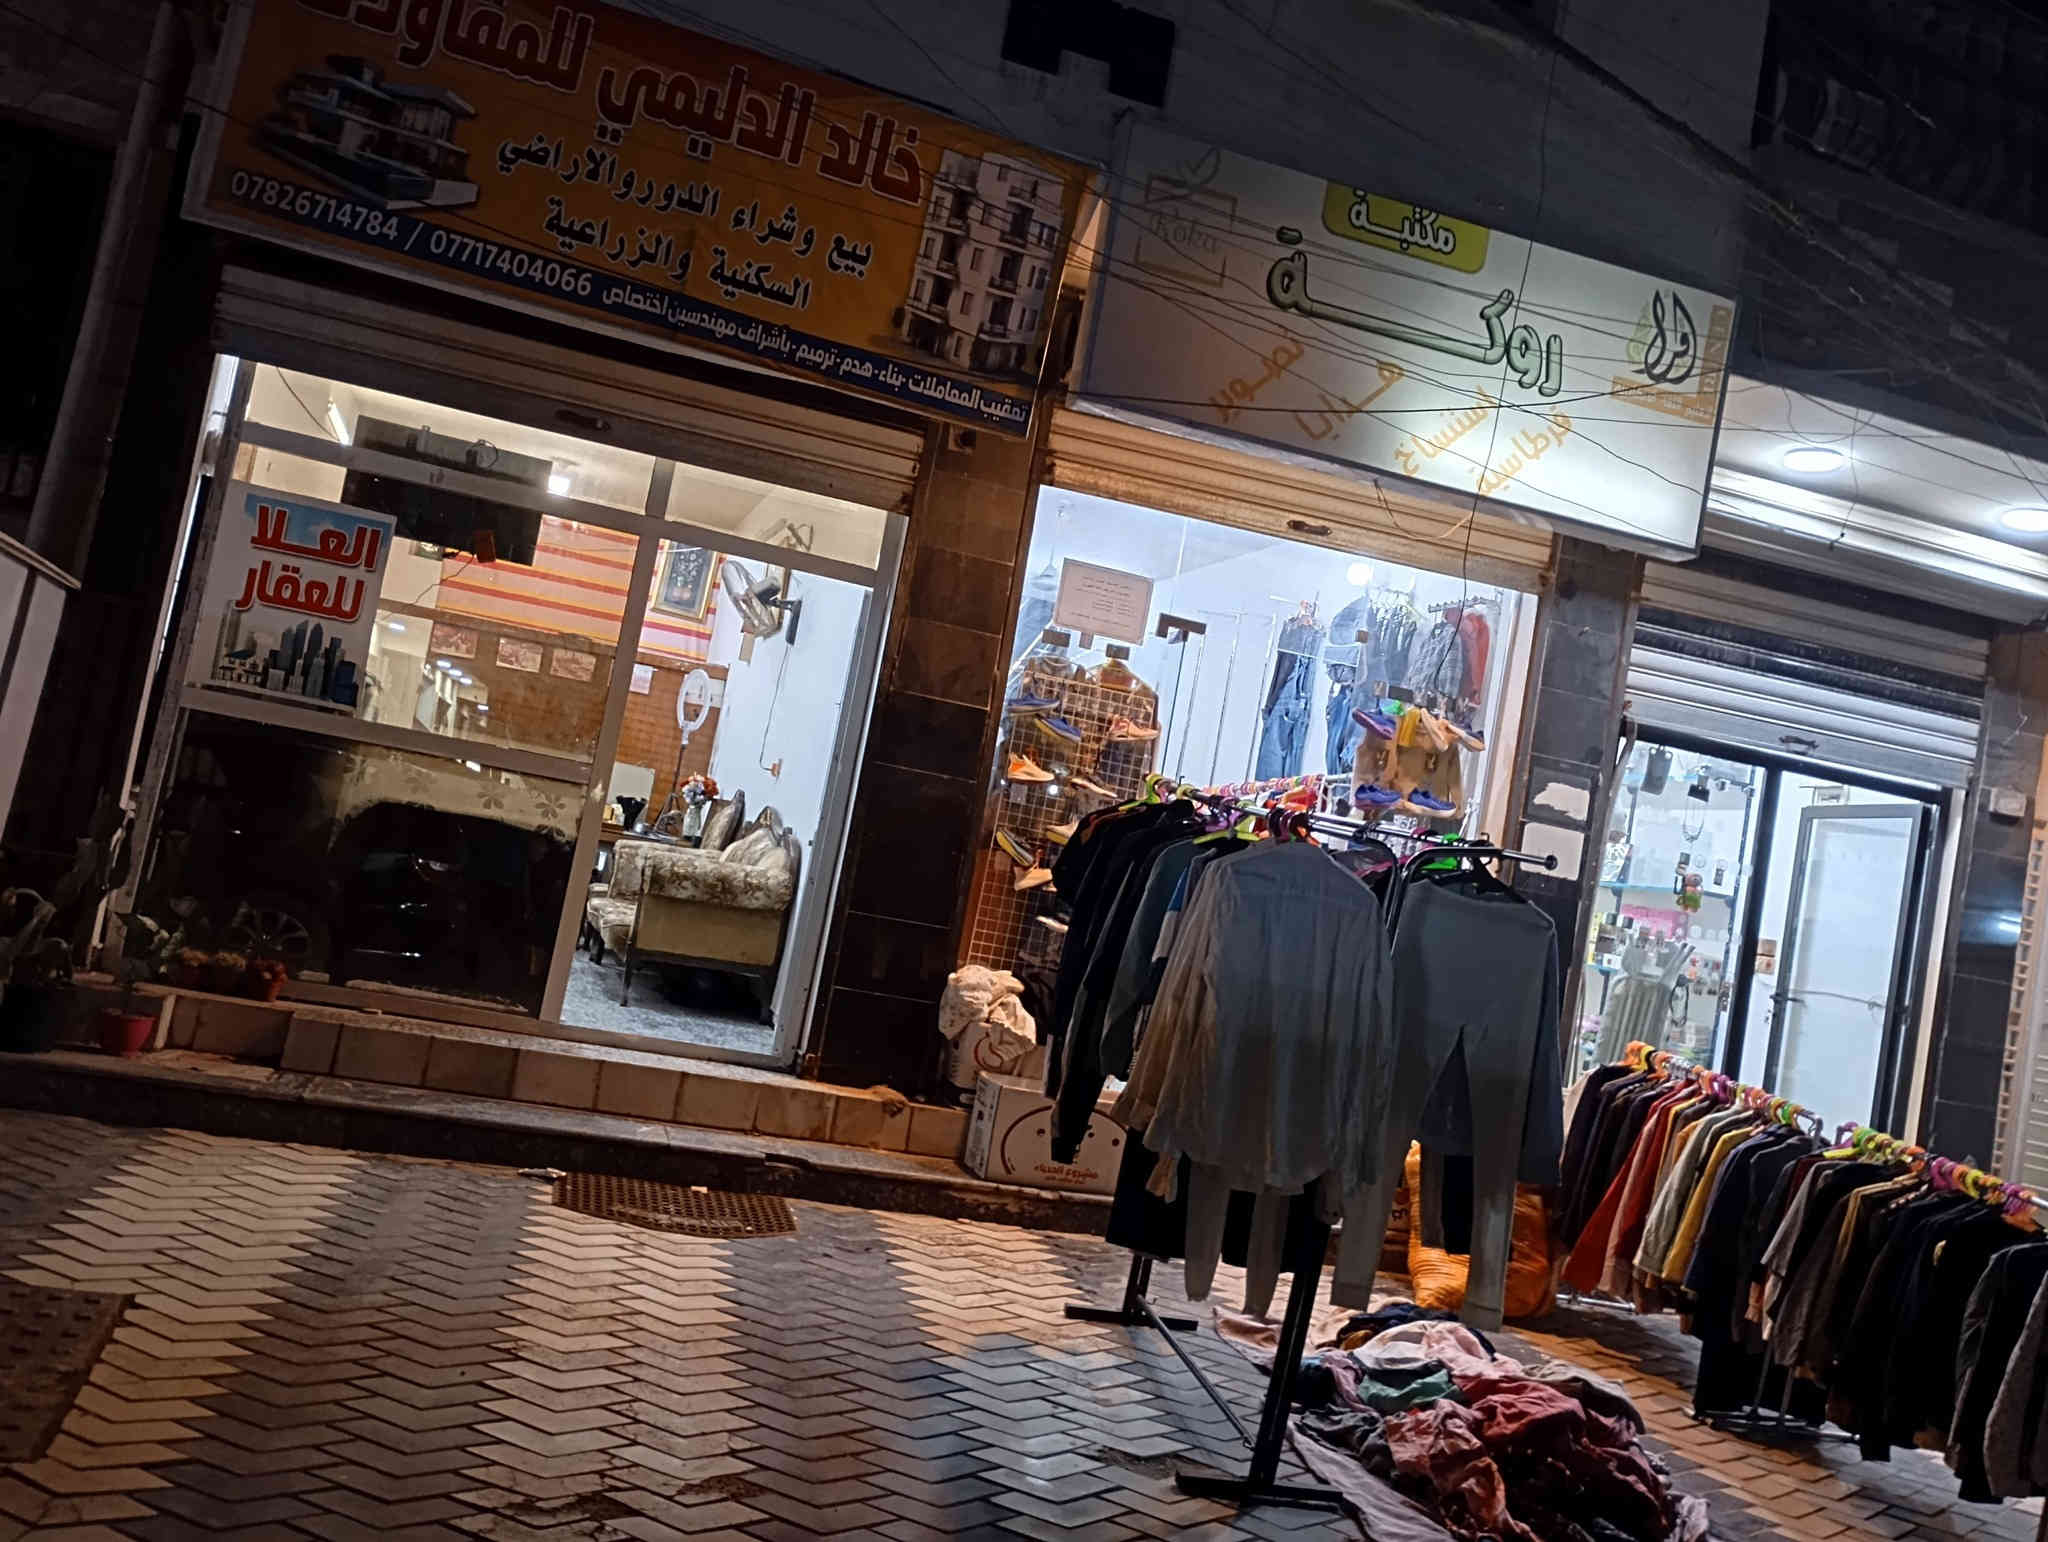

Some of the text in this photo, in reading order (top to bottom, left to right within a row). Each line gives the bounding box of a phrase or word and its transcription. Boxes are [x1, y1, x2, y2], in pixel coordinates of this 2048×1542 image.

[594, 64, 816, 167] الدليمي
[817, 111, 923, 206] خالد
[231, 170, 399, 242] 07826714784
[1349, 188, 1456, 254] مكتبة
[430, 228, 593, 298] 07717404066
[708, 246, 812, 310] السكنية
[826, 233, 874, 279] بيع
[1393, 383, 1498, 476] استنساخ
[1468, 404, 1573, 497] قرطاسية
[250, 503, 384, 572] العلا
[233, 559, 366, 623] للعقار
